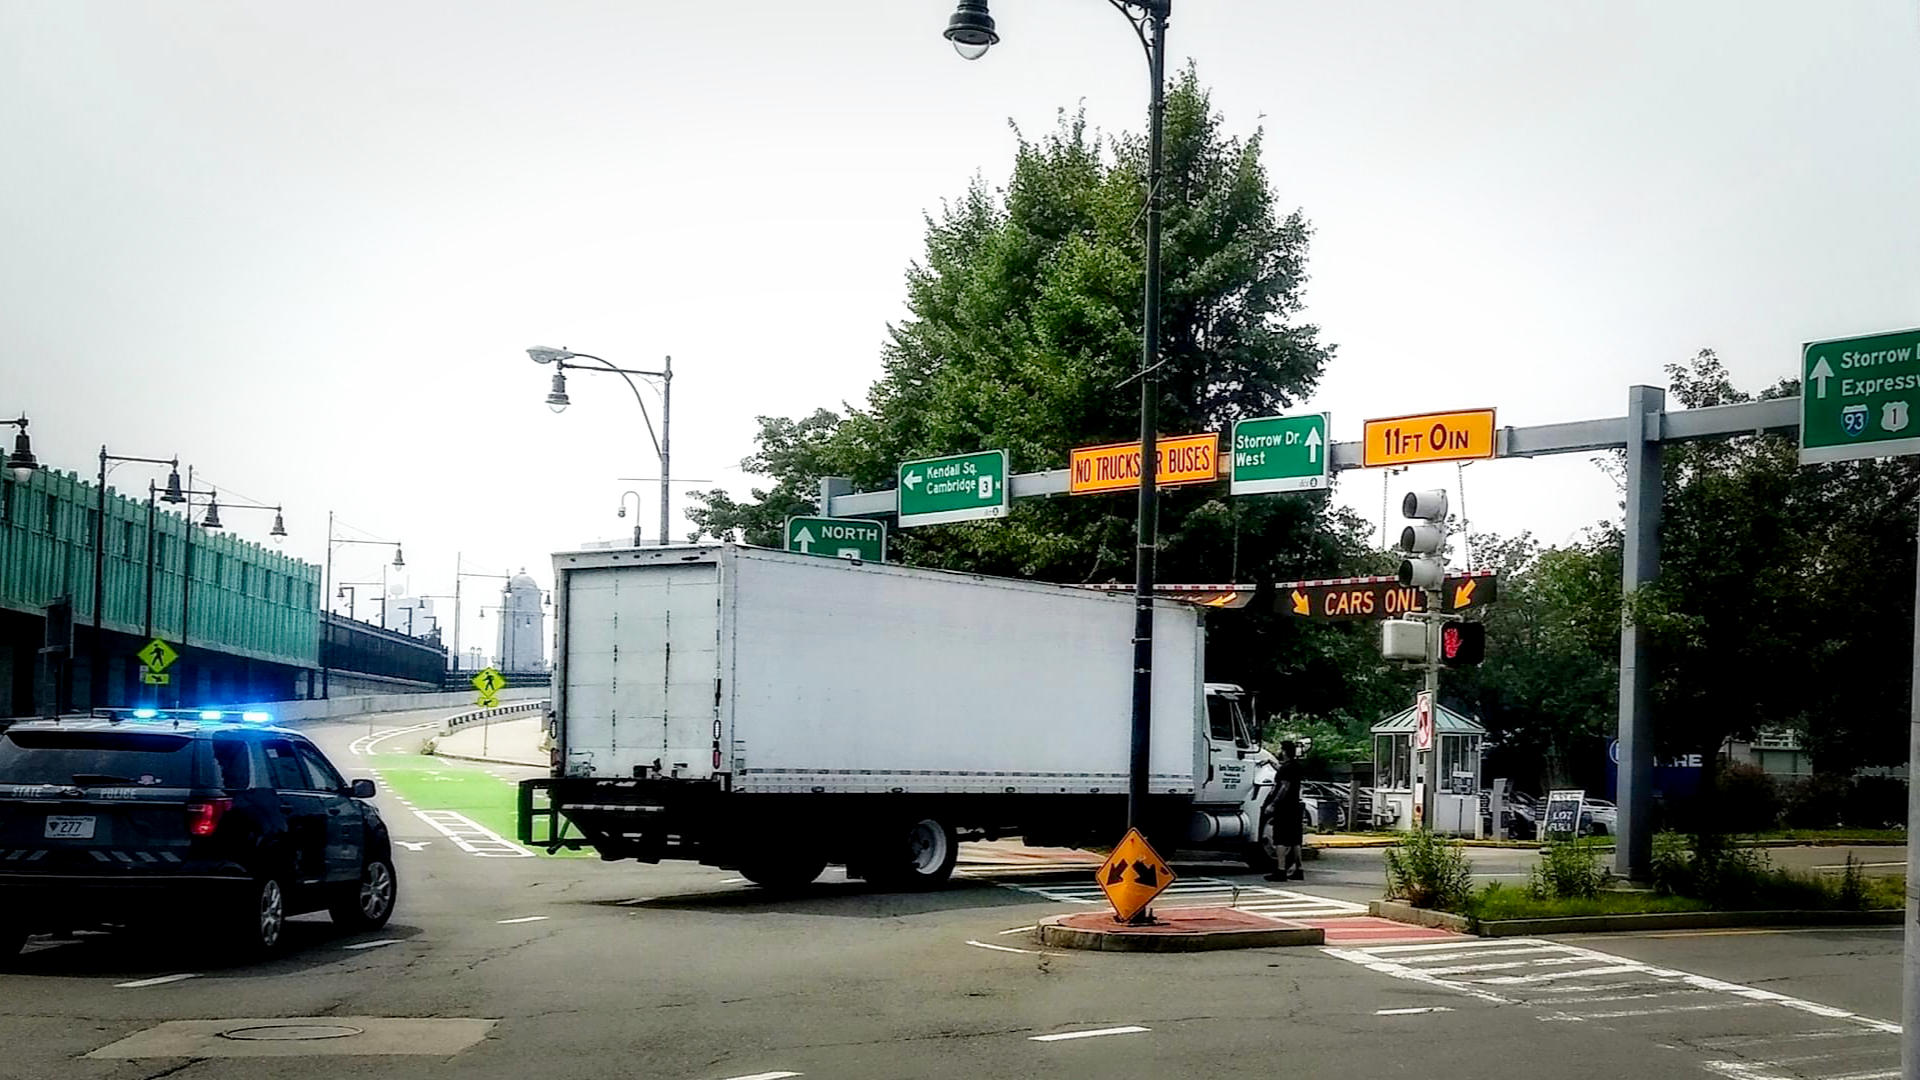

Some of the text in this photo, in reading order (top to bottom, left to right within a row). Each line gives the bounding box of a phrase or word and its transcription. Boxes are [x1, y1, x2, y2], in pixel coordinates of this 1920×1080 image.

[1841, 347, 1912, 369] Storrow
[1842, 374, 1920, 396] Express
[1844, 413, 1865, 431] 93
[1236, 434, 1282, 450] Storrow
[1075, 458, 1091, 484] NO
[1096, 452, 1141, 481] TRUCKS
[1168, 444, 1210, 473] BUSES
[1236, 450, 1265, 467] West
[927, 464, 960, 479] Kendall
[926, 478, 976, 495] Cambridge
[821, 525, 878, 542] NORTH
[1325, 587, 1423, 616] CARS ONL
[11, 787, 137, 799] STATE POLICE
[1553, 811, 1573, 820] LOT
[60, 821, 82, 833] 277
